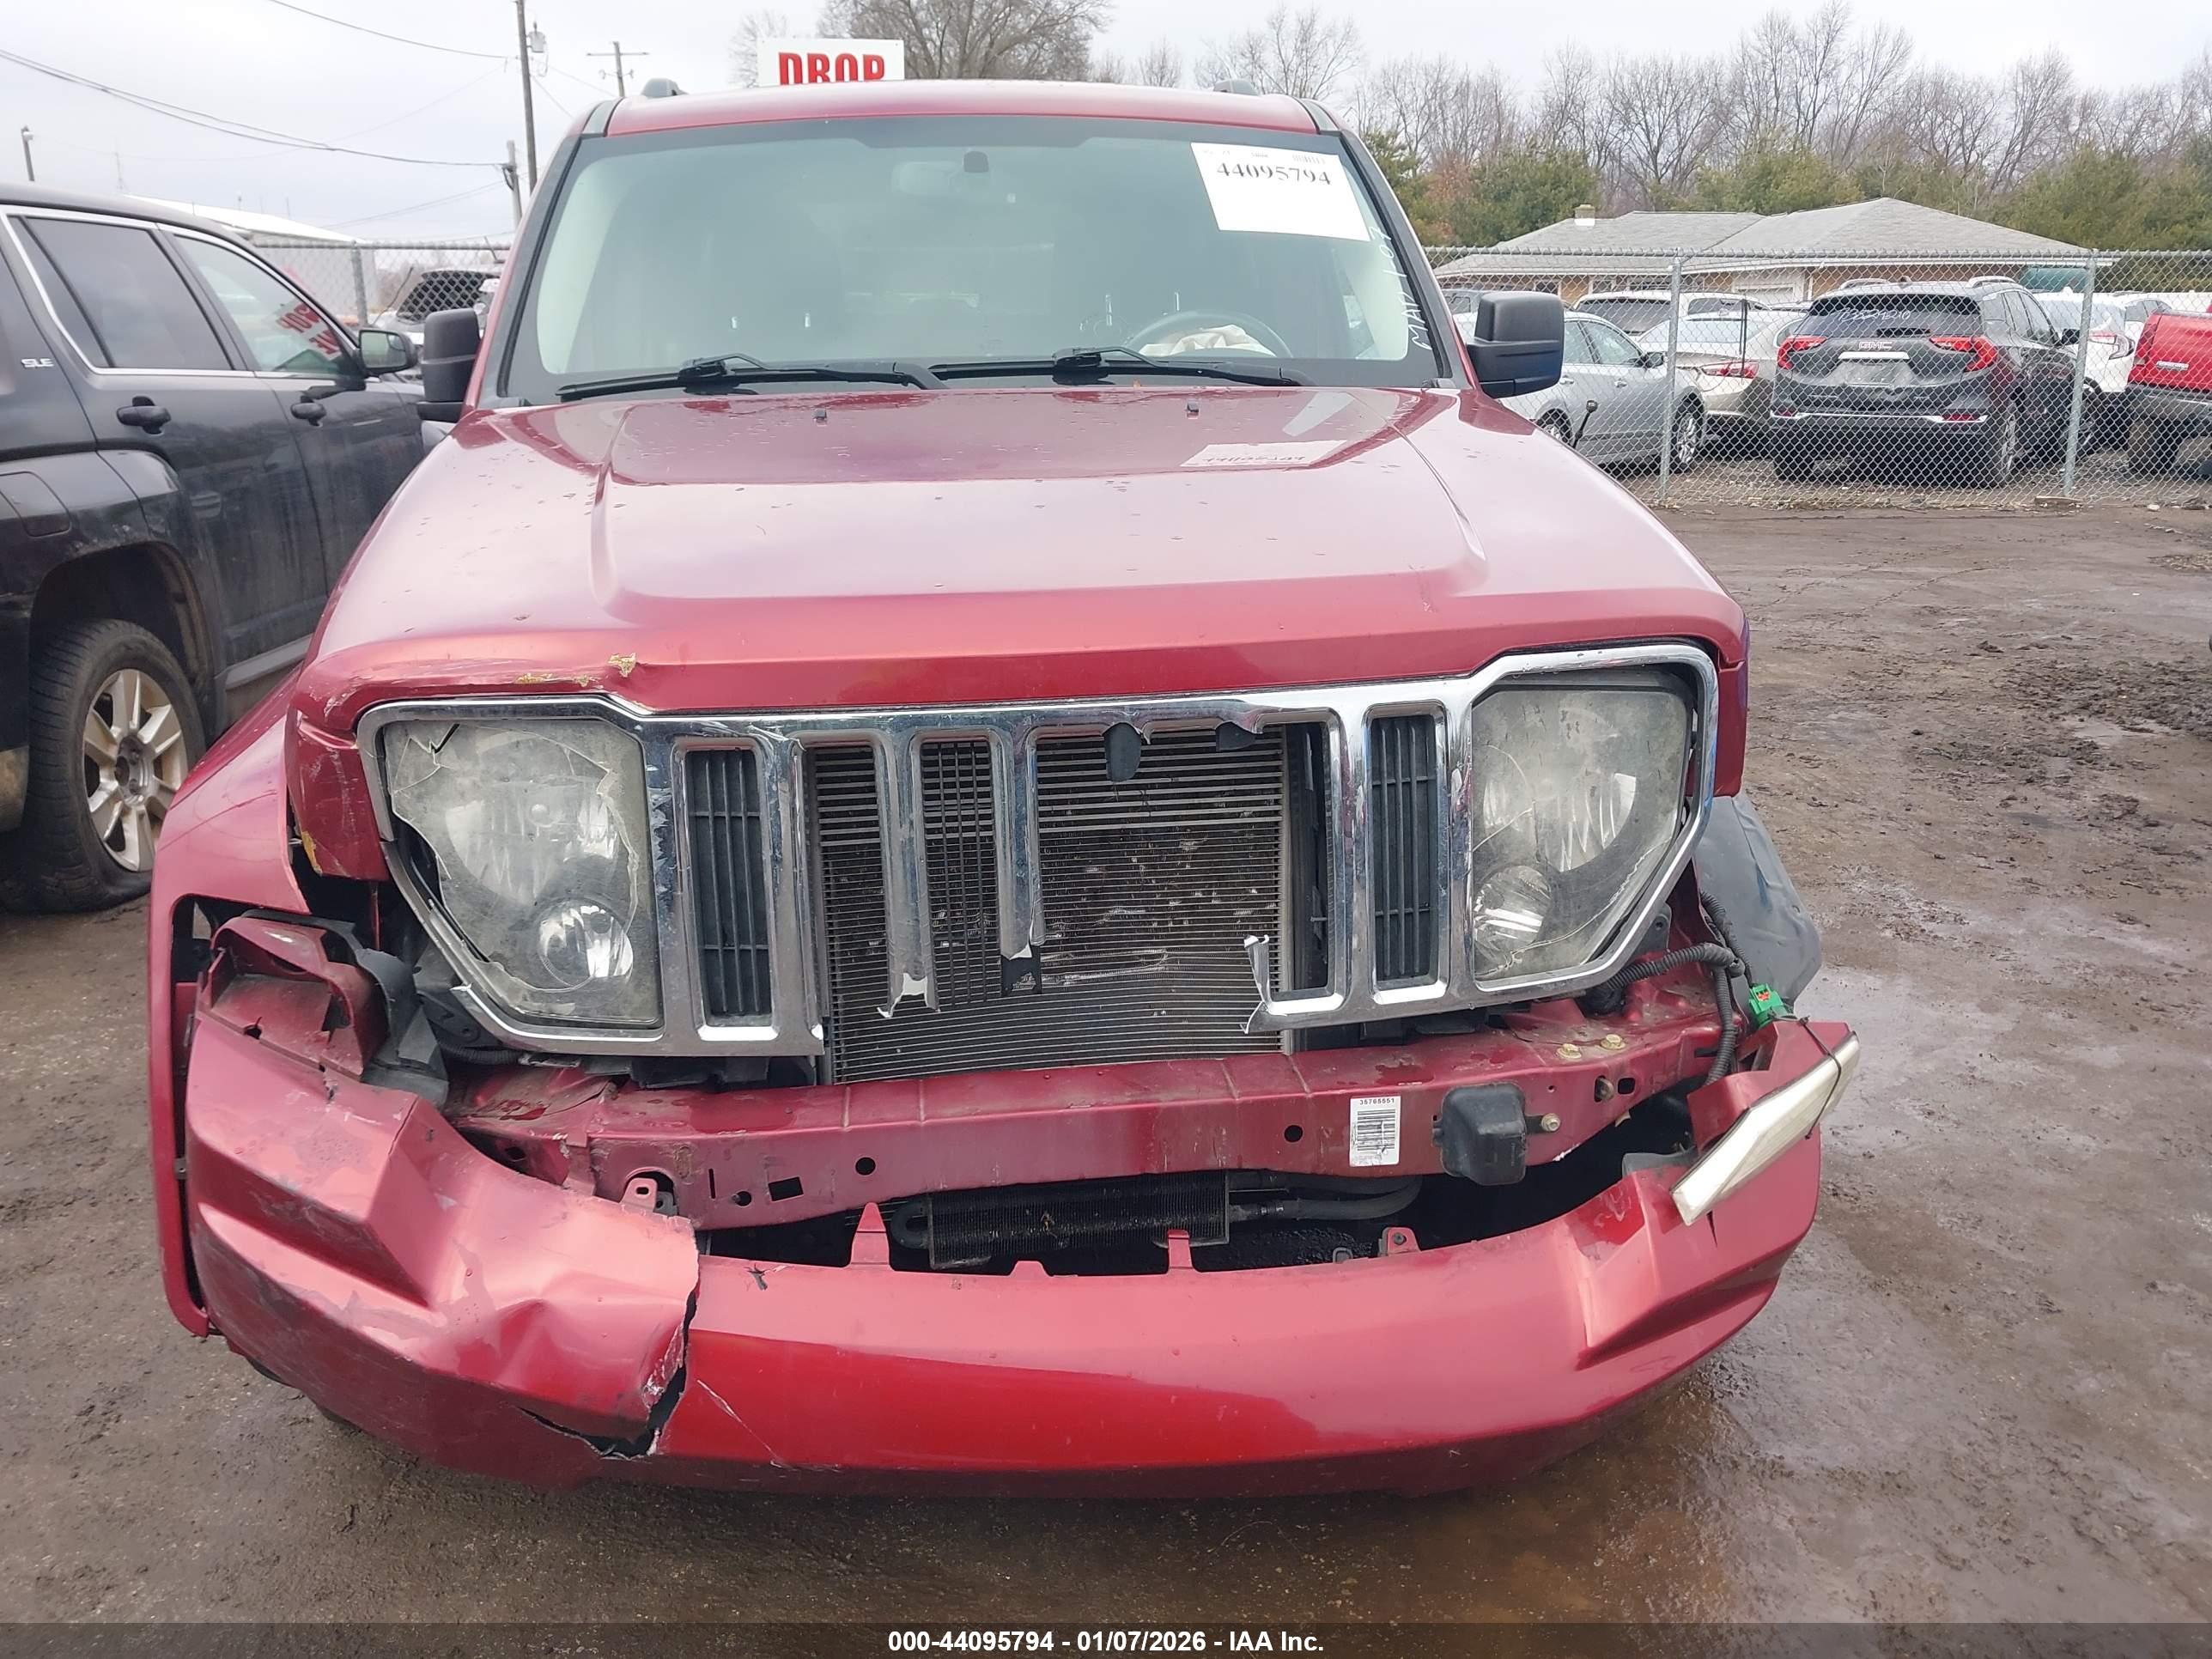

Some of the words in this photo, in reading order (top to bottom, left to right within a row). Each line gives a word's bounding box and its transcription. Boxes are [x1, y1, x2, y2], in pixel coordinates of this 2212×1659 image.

[779, 52, 884, 85] DROP
[1217, 162, 1331, 185] 44095794
[1858, 341, 1893, 349] GMC
[21, 358, 54, 368] SLE
